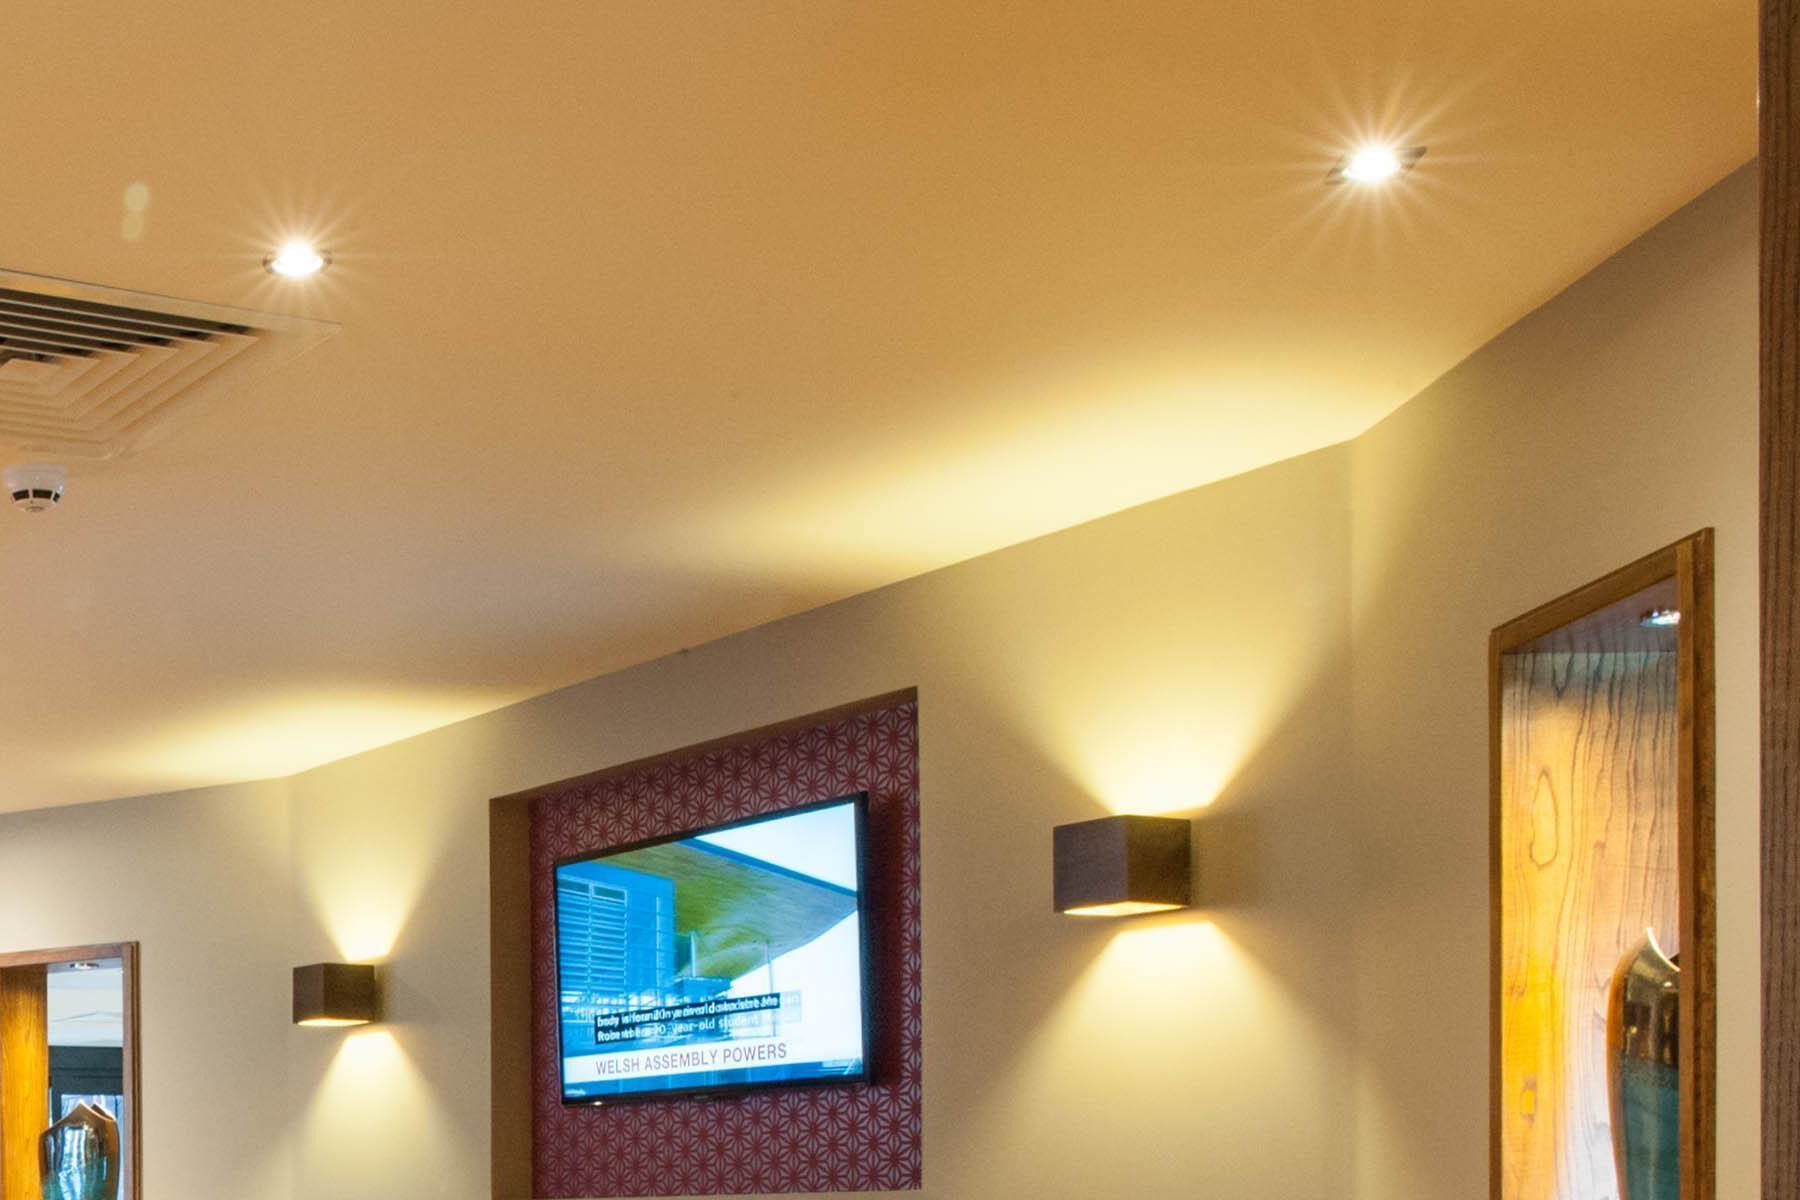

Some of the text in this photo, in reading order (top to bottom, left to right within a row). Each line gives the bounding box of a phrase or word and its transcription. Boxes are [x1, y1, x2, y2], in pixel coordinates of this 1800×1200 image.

[595, 1043, 787, 1075] WELSH ASSEMBLY POWERS
